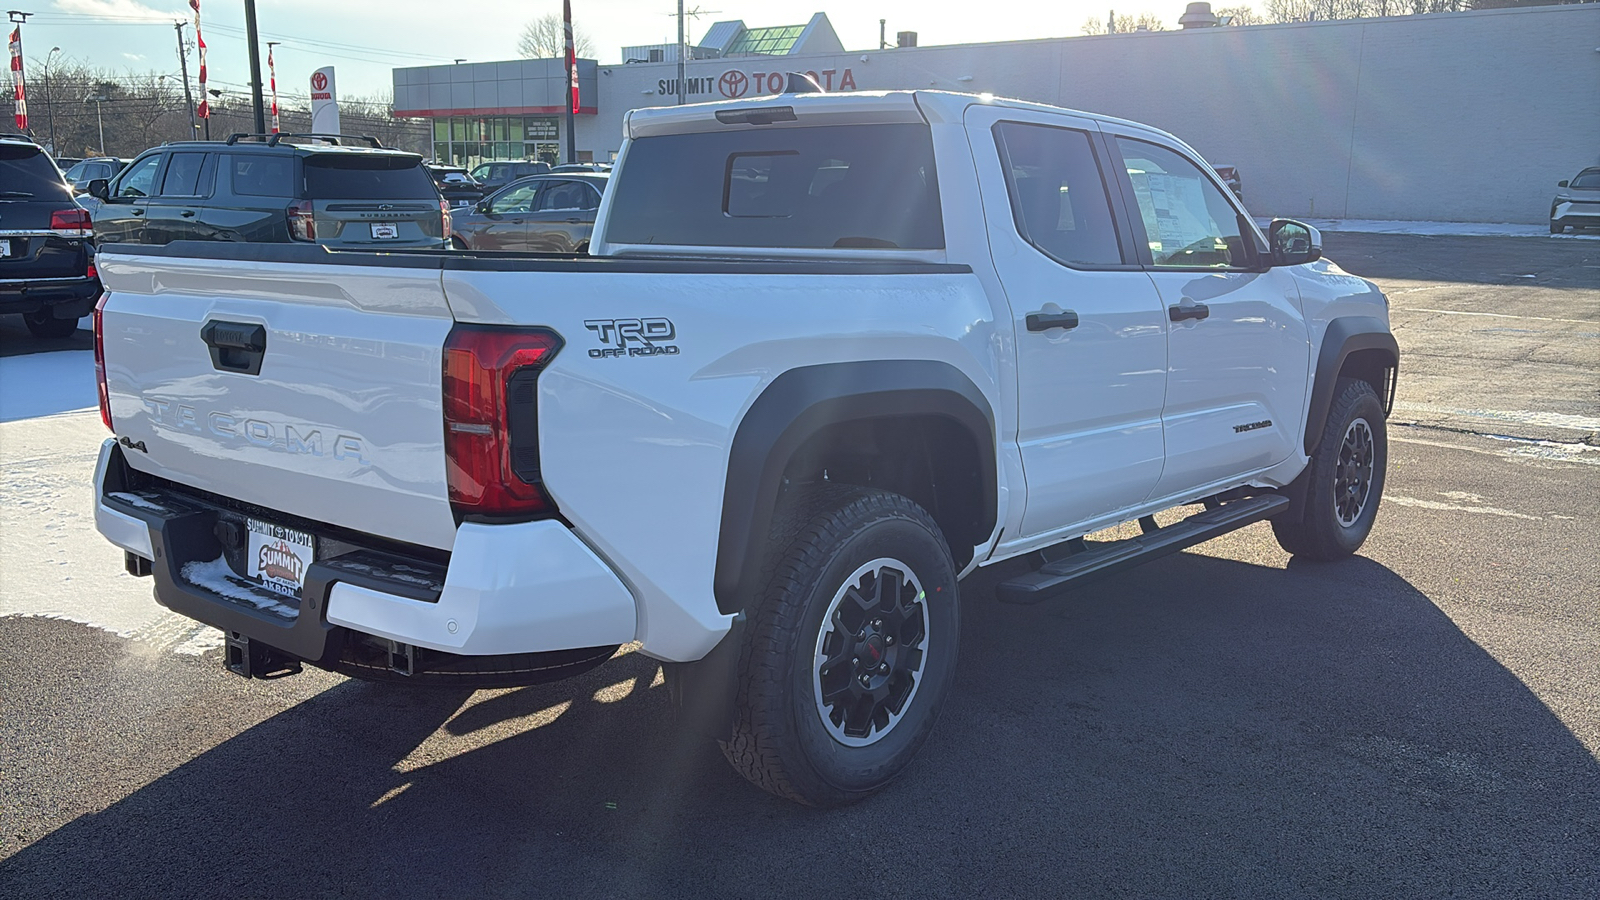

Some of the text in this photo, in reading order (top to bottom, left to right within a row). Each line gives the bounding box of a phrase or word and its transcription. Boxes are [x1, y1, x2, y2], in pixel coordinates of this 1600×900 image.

[752, 68, 857, 94] TOTA
[216, 330, 243, 342] TOYOTA
[583, 317, 677, 348] TRD
[588, 345, 680, 358] OFF ROAD
[143, 397, 372, 466] TACOMA
[246, 518, 313, 548] SUMMIT TOYOTA
[260, 547, 301, 580] SUMMIT
[262, 579, 295, 597] AKRON
